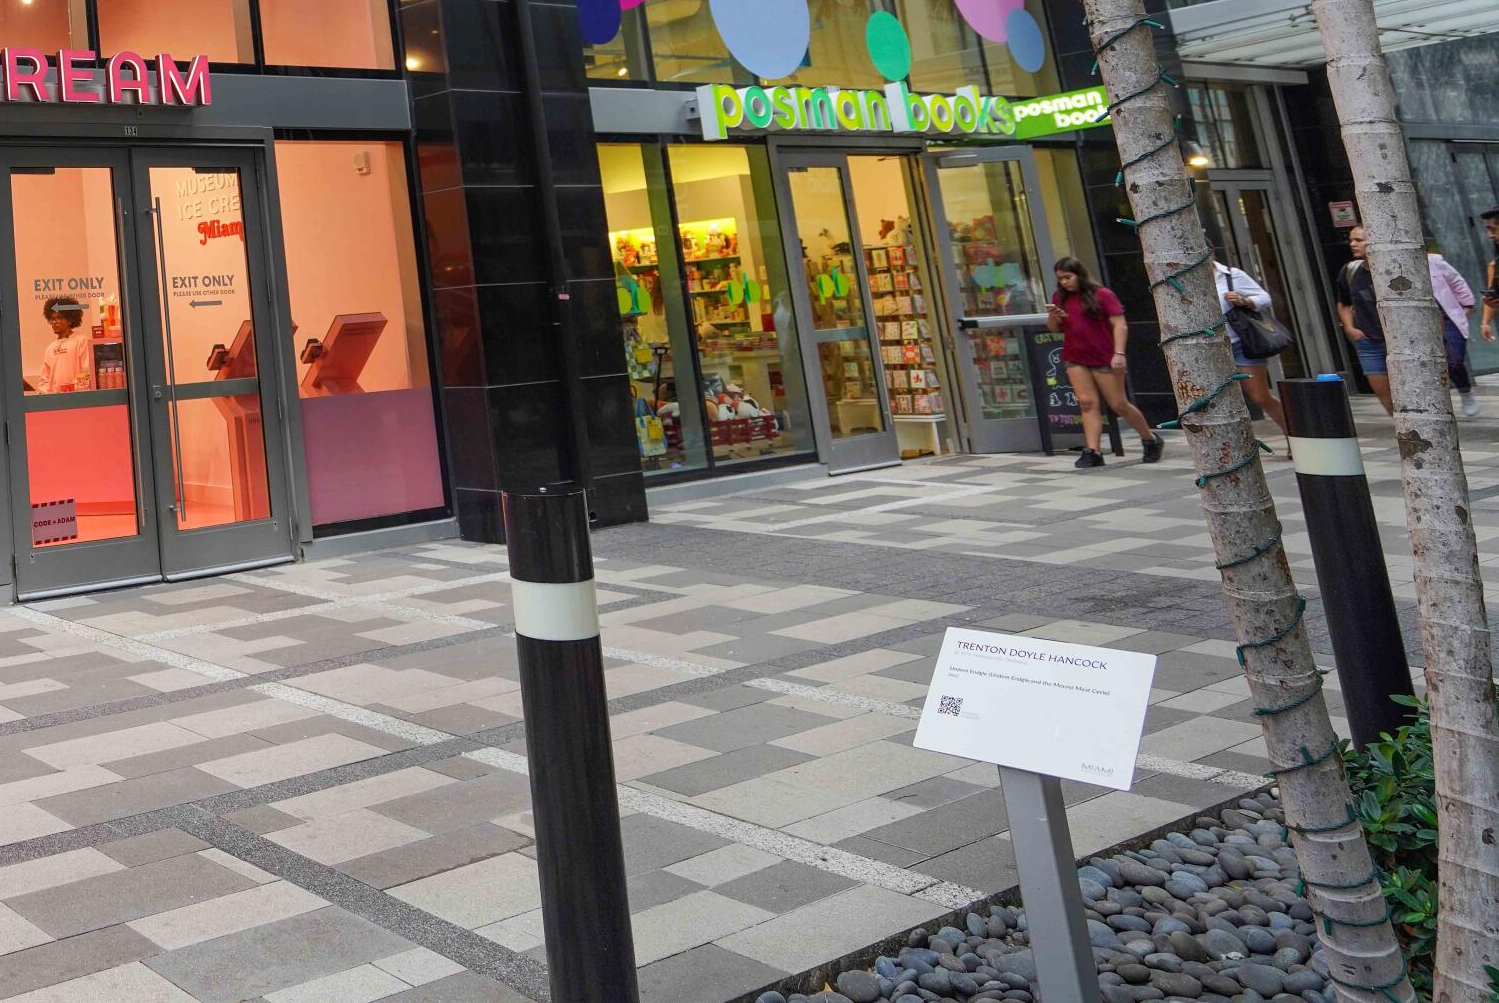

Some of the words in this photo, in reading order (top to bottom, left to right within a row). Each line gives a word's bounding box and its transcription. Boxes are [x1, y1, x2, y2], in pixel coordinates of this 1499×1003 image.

[696, 84, 892, 141] posman
[884, 80, 1017, 136] books
[1013, 91, 1103, 123] posman
[176, 173, 238, 198] MUSEUM
[179, 201, 202, 221] ICE
[210, 195, 241, 215] CRE
[197, 219, 244, 246] Miam
[34, 278, 64, 292] EXIT
[67, 277, 105, 290] ONLY
[172, 276, 199, 288] EXIT
[202, 274, 235, 287] ONLY
[33, 519, 52, 528] CODE
[57, 516, 76, 524] ADAM
[957, 640, 1007, 656] TRENTON
[1009, 648, 1046, 661] DOYLE
[1048, 654, 1108, 670] HANCOCK
[1081, 763, 1114, 775] MIAMI
